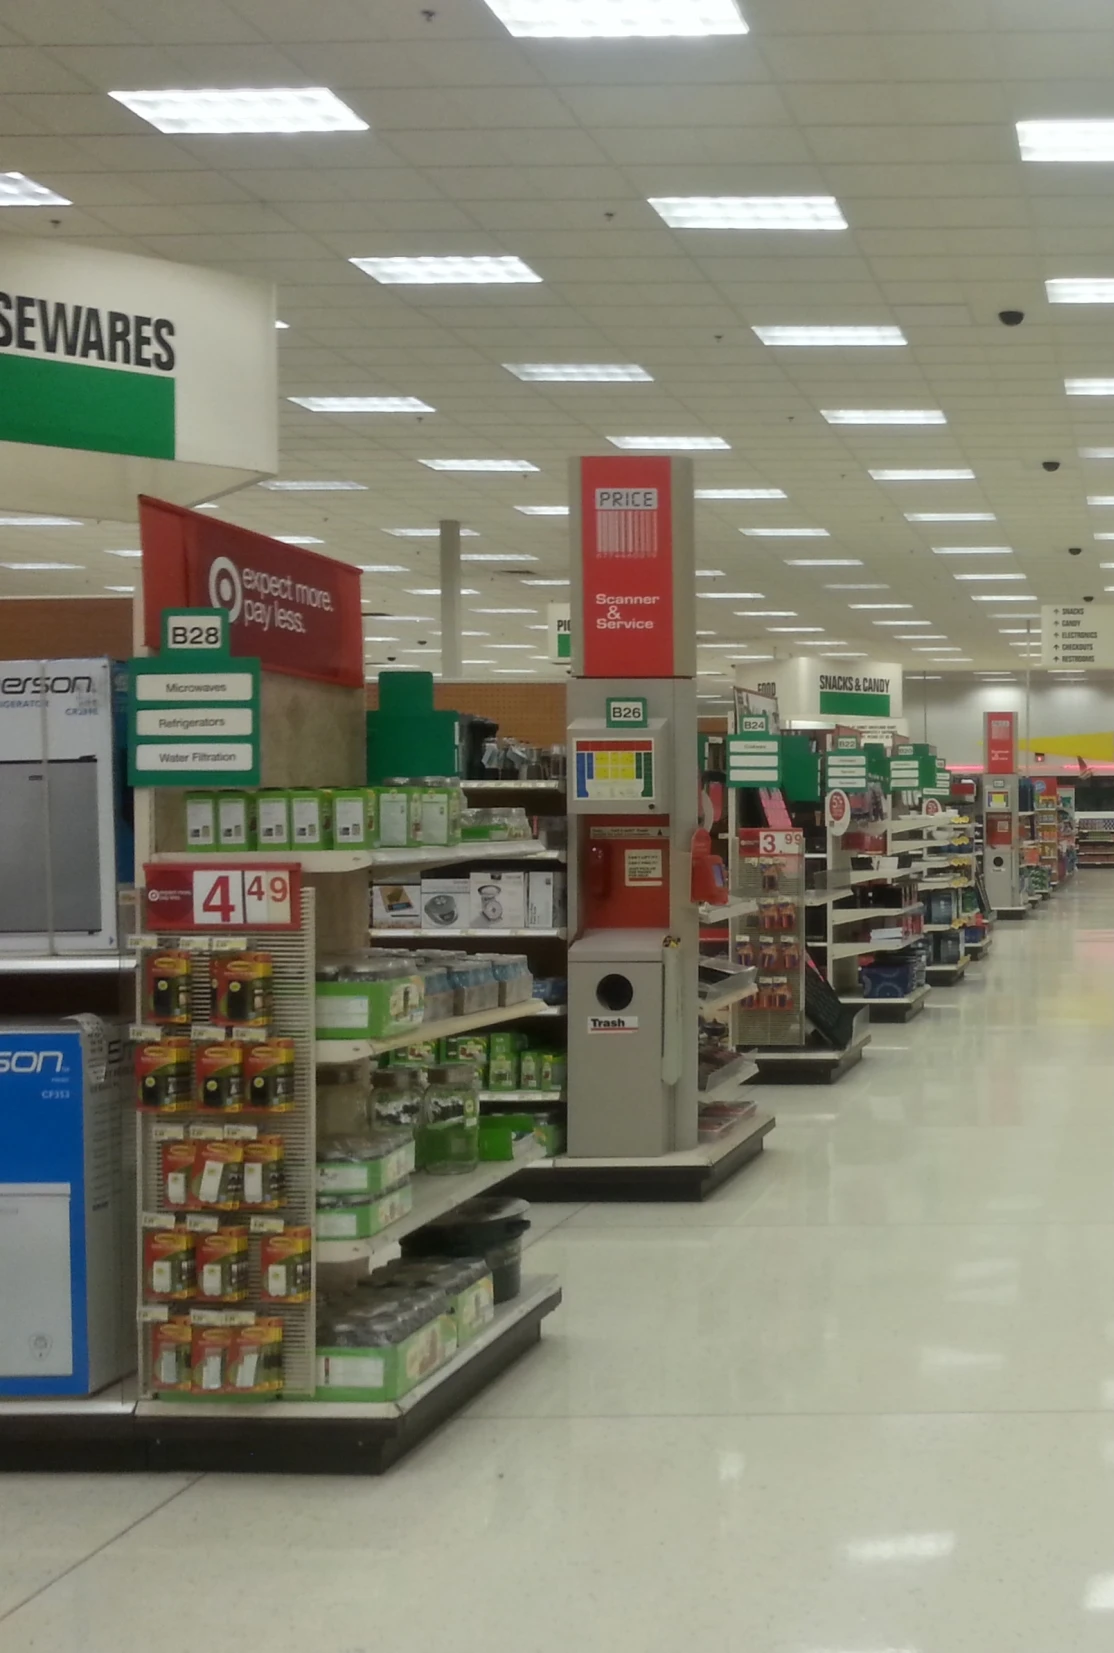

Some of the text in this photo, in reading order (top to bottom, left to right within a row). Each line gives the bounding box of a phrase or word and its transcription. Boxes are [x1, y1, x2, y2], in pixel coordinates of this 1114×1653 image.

[0, 290, 175, 371] SEWARES
[599, 491, 653, 507] PRICE
[242, 568, 334, 612] expect more.
[595, 593, 660, 605] Scanner
[244, 599, 306, 633] pay less.
[607, 605, 621, 620] &
[596, 618, 654, 629] Service
[171, 626, 219, 645] B28
[1, 676, 92, 694] erson
[166, 683, 227, 693] Microwaves
[758, 682, 776, 697] FOOD
[820, 675, 890, 693] SNACKS & CANDY
[612, 706, 641, 718] B26
[158, 717, 225, 729] Refrigerators
[744, 721, 764, 729] B24
[159, 752, 236, 763] Water Filtration
[590, 1017, 625, 1027] Trash
